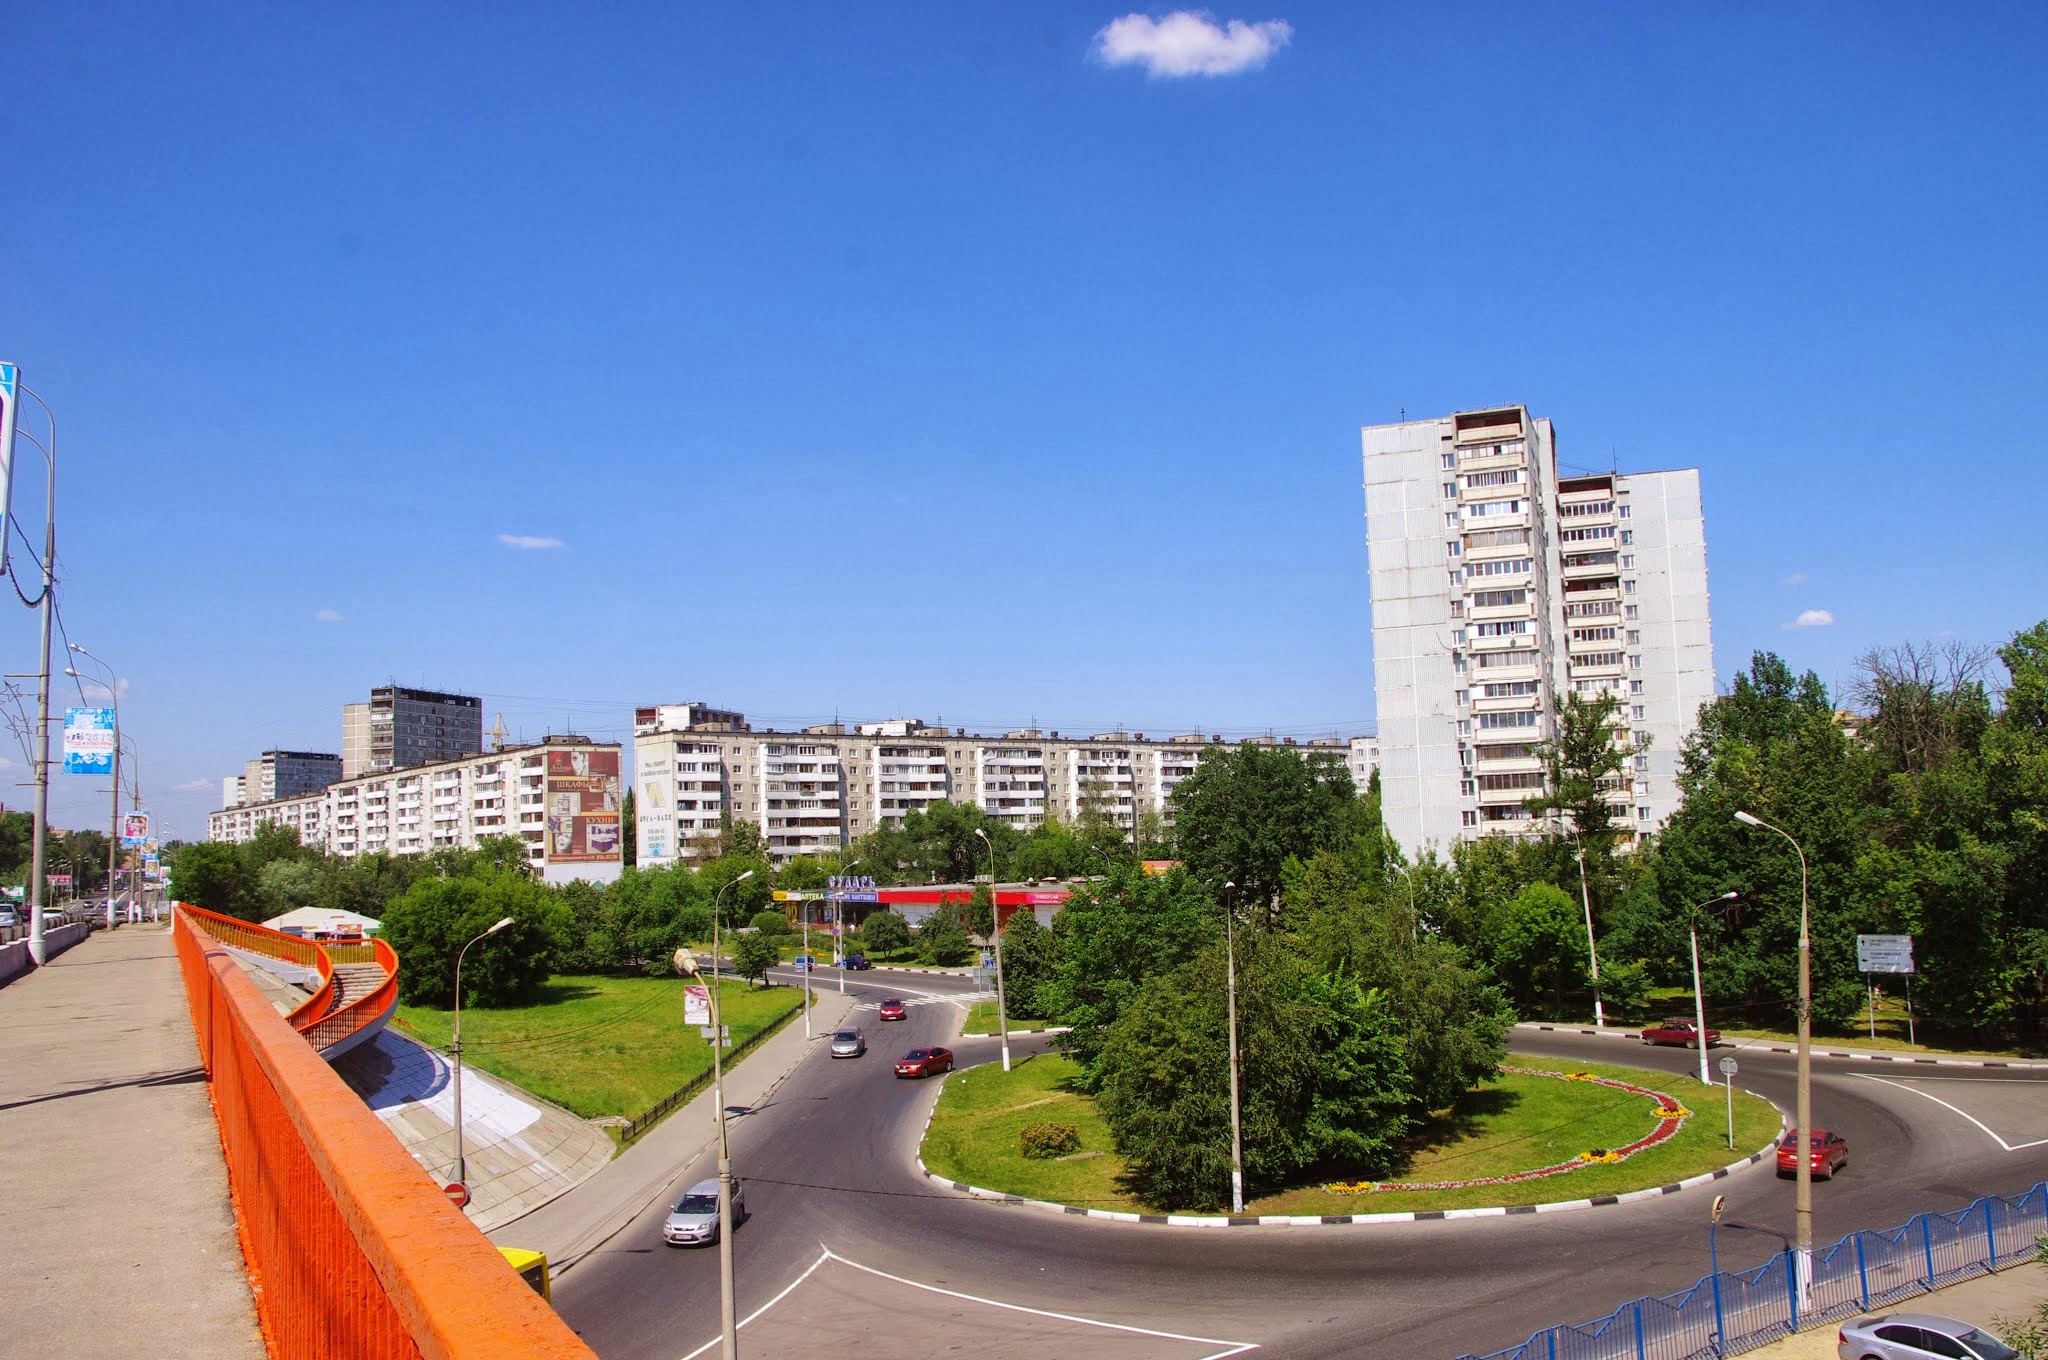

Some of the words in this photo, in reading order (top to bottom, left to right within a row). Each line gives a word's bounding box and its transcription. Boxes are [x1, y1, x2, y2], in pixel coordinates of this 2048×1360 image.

[556, 780, 590, 788] ШКАФЫ
[585, 816, 614, 824] КУХНИ
[828, 875, 876, 890] СУДАРЬ
[801, 893, 824, 901] АПТЕКА
